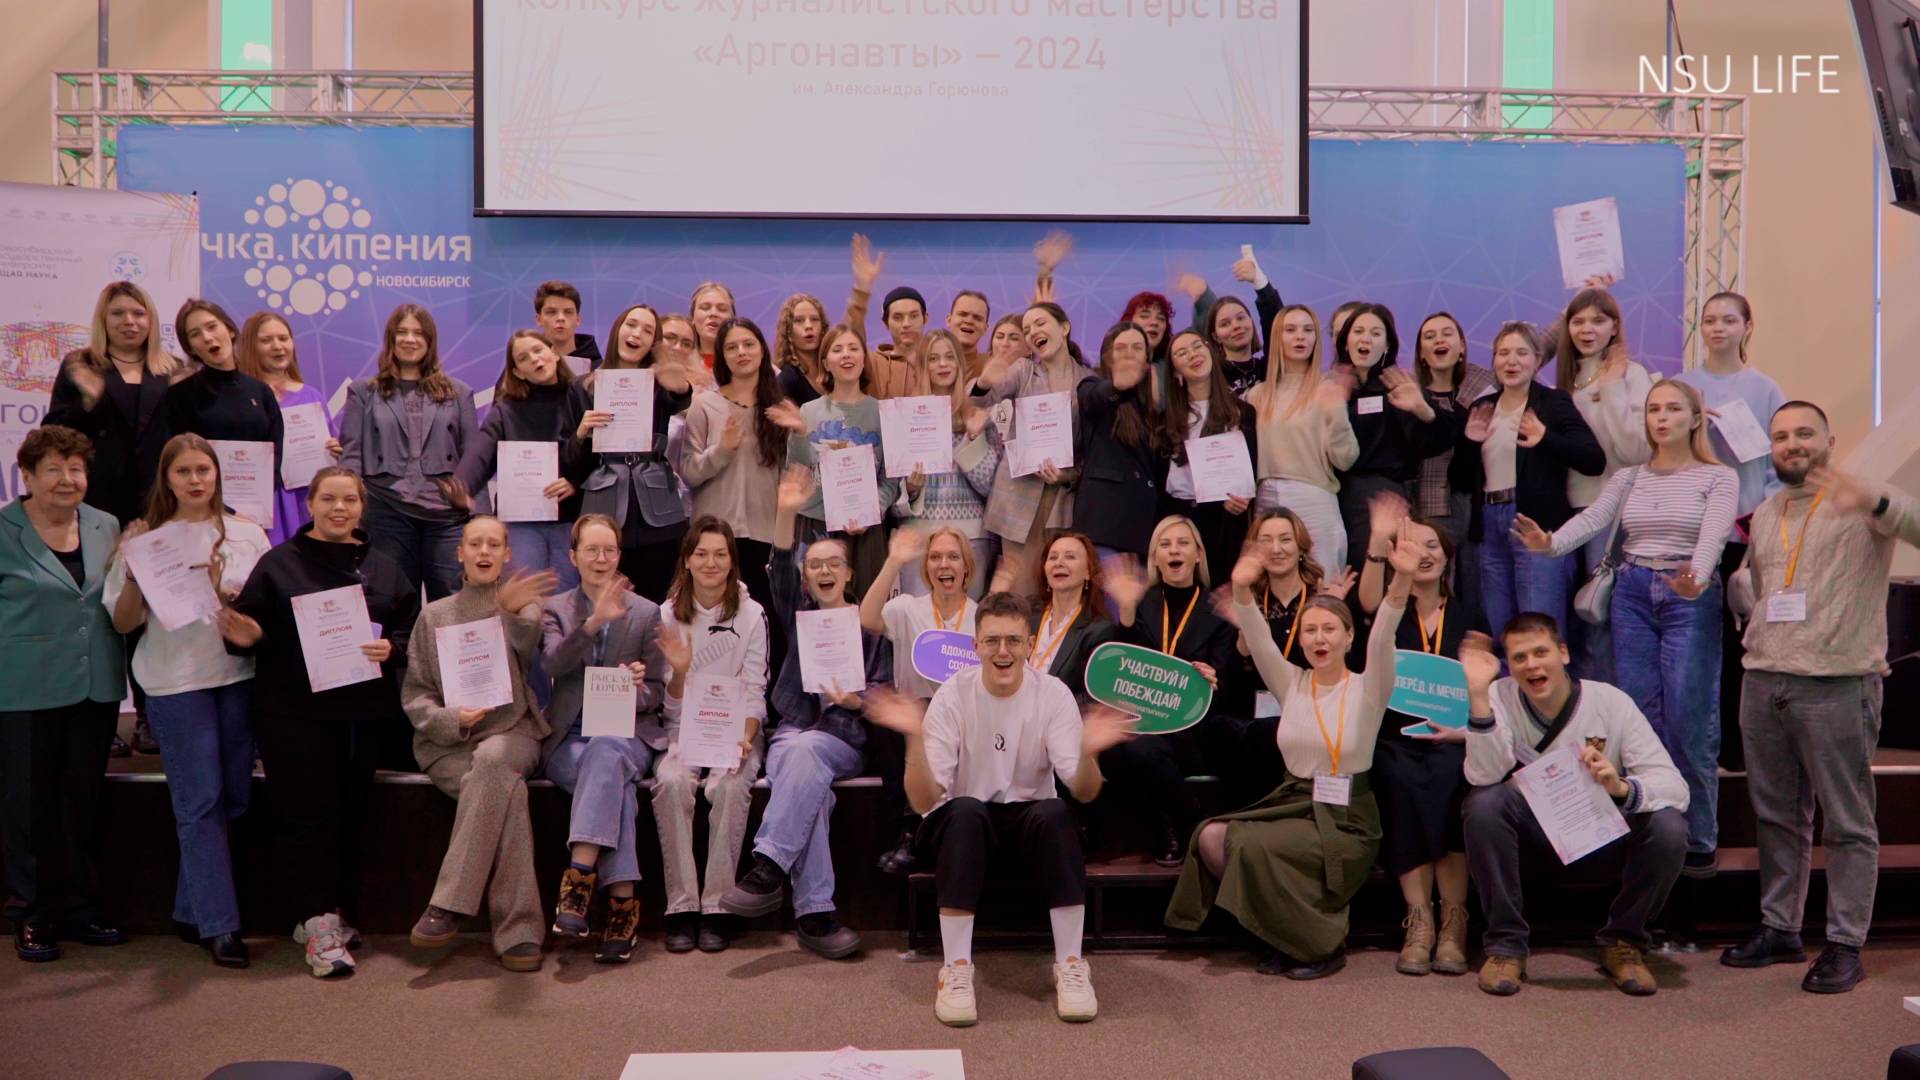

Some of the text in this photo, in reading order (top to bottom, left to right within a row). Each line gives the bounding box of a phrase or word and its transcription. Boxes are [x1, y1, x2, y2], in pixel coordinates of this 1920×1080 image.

[1047, 0, 1278, 28] мастерства
[692, 31, 962, 76] «Аргонавты»
[1014, 35, 1107, 70] 2024
[823, 79, 923, 101] Александра
[928, 80, 1009, 101] Горюнова
[291, 233, 472, 262] кипения
[375, 274, 472, 288] НОВОСИБИРСК
[1119, 656, 1189, 691] УЧАСТВУЙ И
[1113, 678, 1182, 711] ПОБЕЖДАЙ!
[1428, 682, 1436, 695] К
